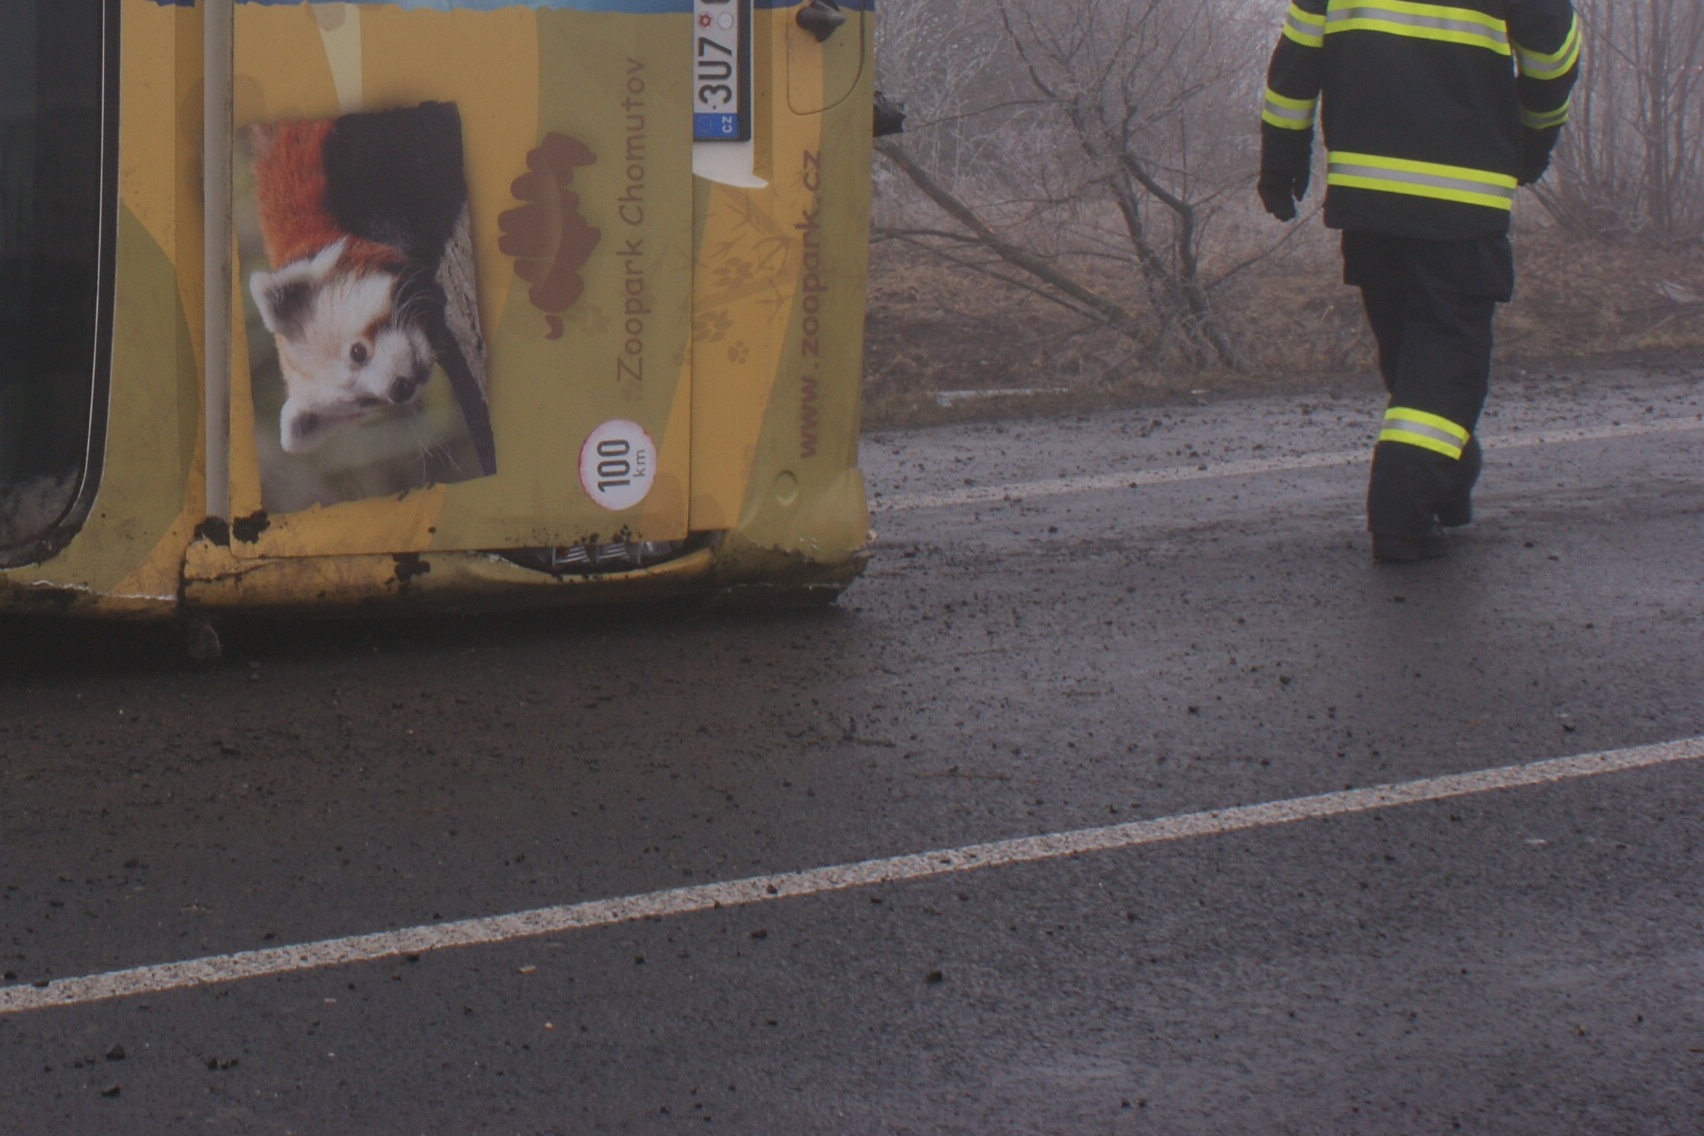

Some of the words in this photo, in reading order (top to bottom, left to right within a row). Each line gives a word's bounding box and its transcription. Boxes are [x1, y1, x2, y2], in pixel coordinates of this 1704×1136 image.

[698, 37, 732, 104] 3U7
[618, 56, 646, 226] Chomutov
[720, 115, 734, 134] CZ
[616, 239, 649, 382] Zoopark
[795, 149, 826, 458] www.zoopark.cz
[597, 439, 631, 492] 100
[632, 449, 647, 478] km
